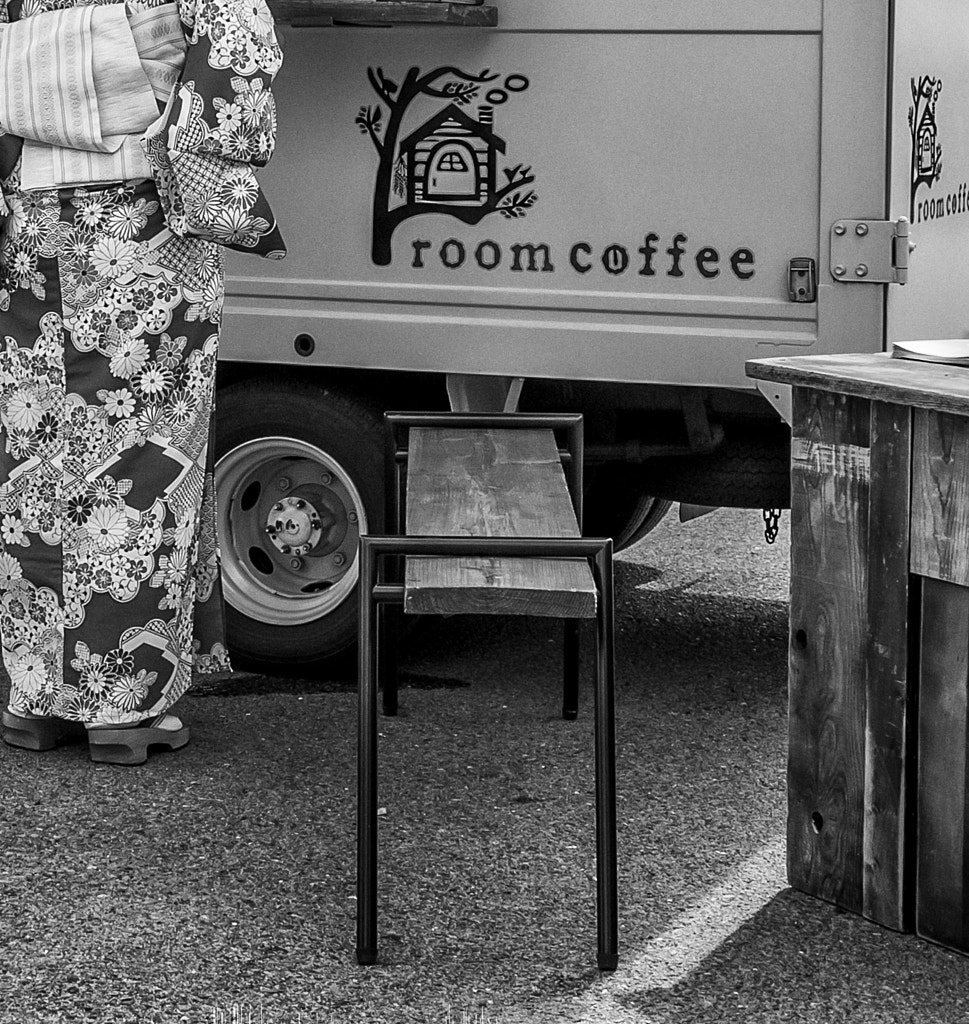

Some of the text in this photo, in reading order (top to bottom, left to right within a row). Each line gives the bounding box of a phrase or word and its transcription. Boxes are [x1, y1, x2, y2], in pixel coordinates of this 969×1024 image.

[918, 197, 945, 224] room
[411, 232, 755, 280] room coffee
